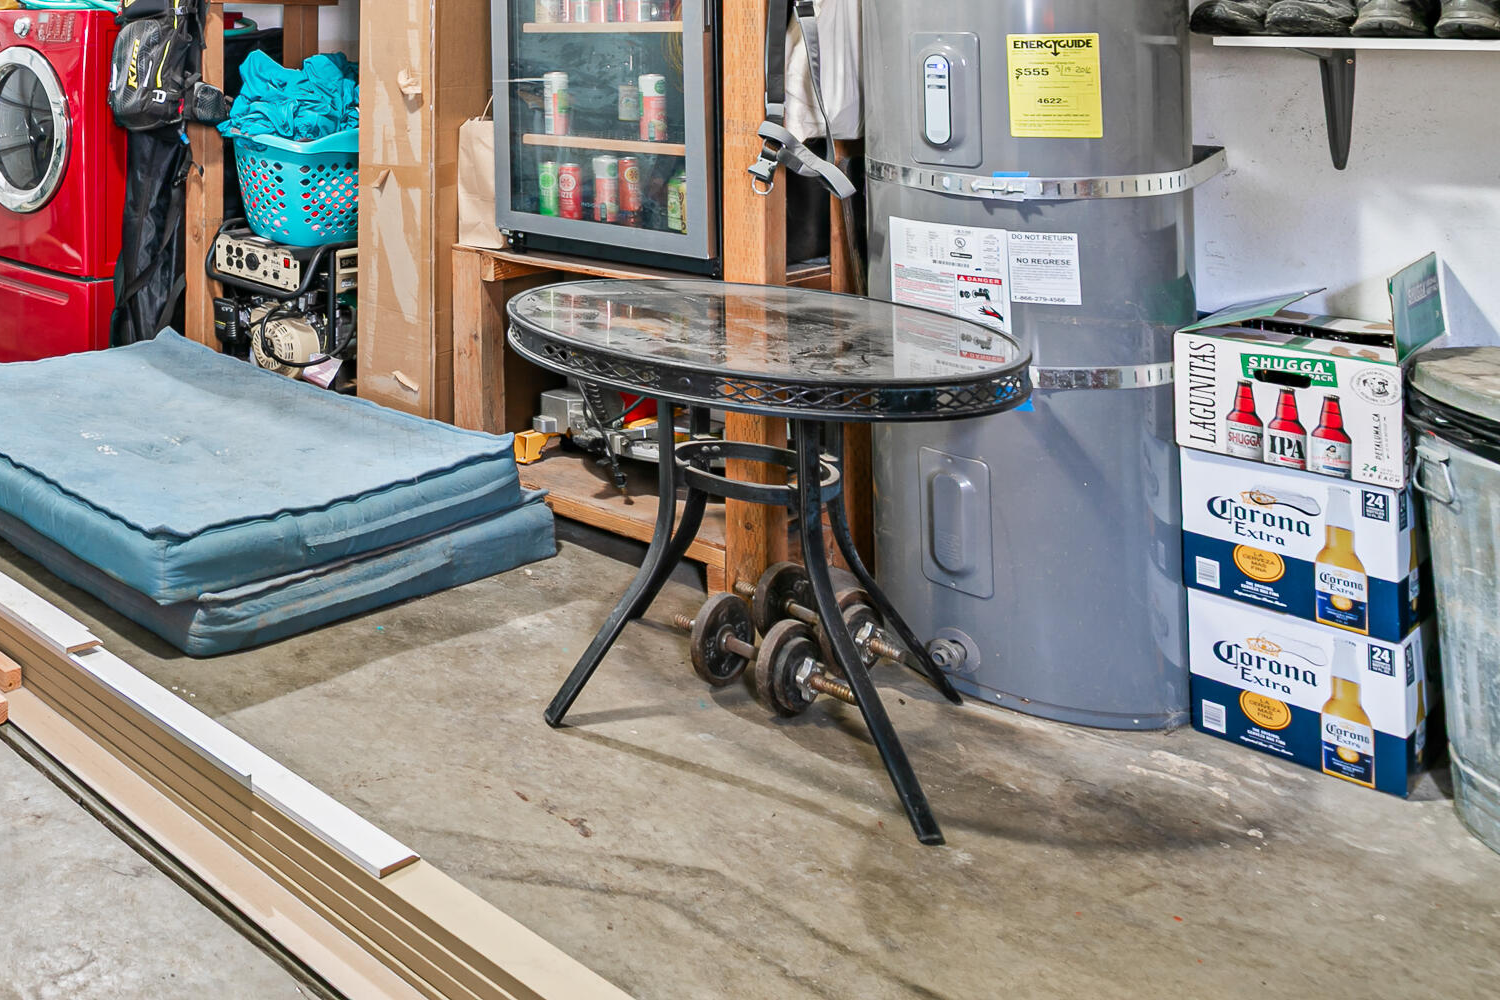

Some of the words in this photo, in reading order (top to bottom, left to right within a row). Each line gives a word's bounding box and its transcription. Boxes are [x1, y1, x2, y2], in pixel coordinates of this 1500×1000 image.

[1013, 39, 1092, 49] ENERGYGUIDE
[1015, 67, 1049, 76] $555
[1031, 258, 1072, 266] REGRESE
[1189, 341, 1216, 444] LAGUNITAS
[1228, 431, 1261, 447] SHUGGA
[1269, 434, 1305, 460] IPA
[1362, 463, 1378, 473] 24
[1365, 492, 1385, 509] 24
[1207, 495, 1312, 537] Corona
[1234, 521, 1286, 547] Extra
[1319, 571, 1364, 592] Corona
[1329, 584, 1354, 596] Extra
[1213, 639, 1318, 687] Corona
[1371, 647, 1390, 663] 24
[1241, 667, 1292, 695] Extra
[1325, 722, 1371, 744] Corona
